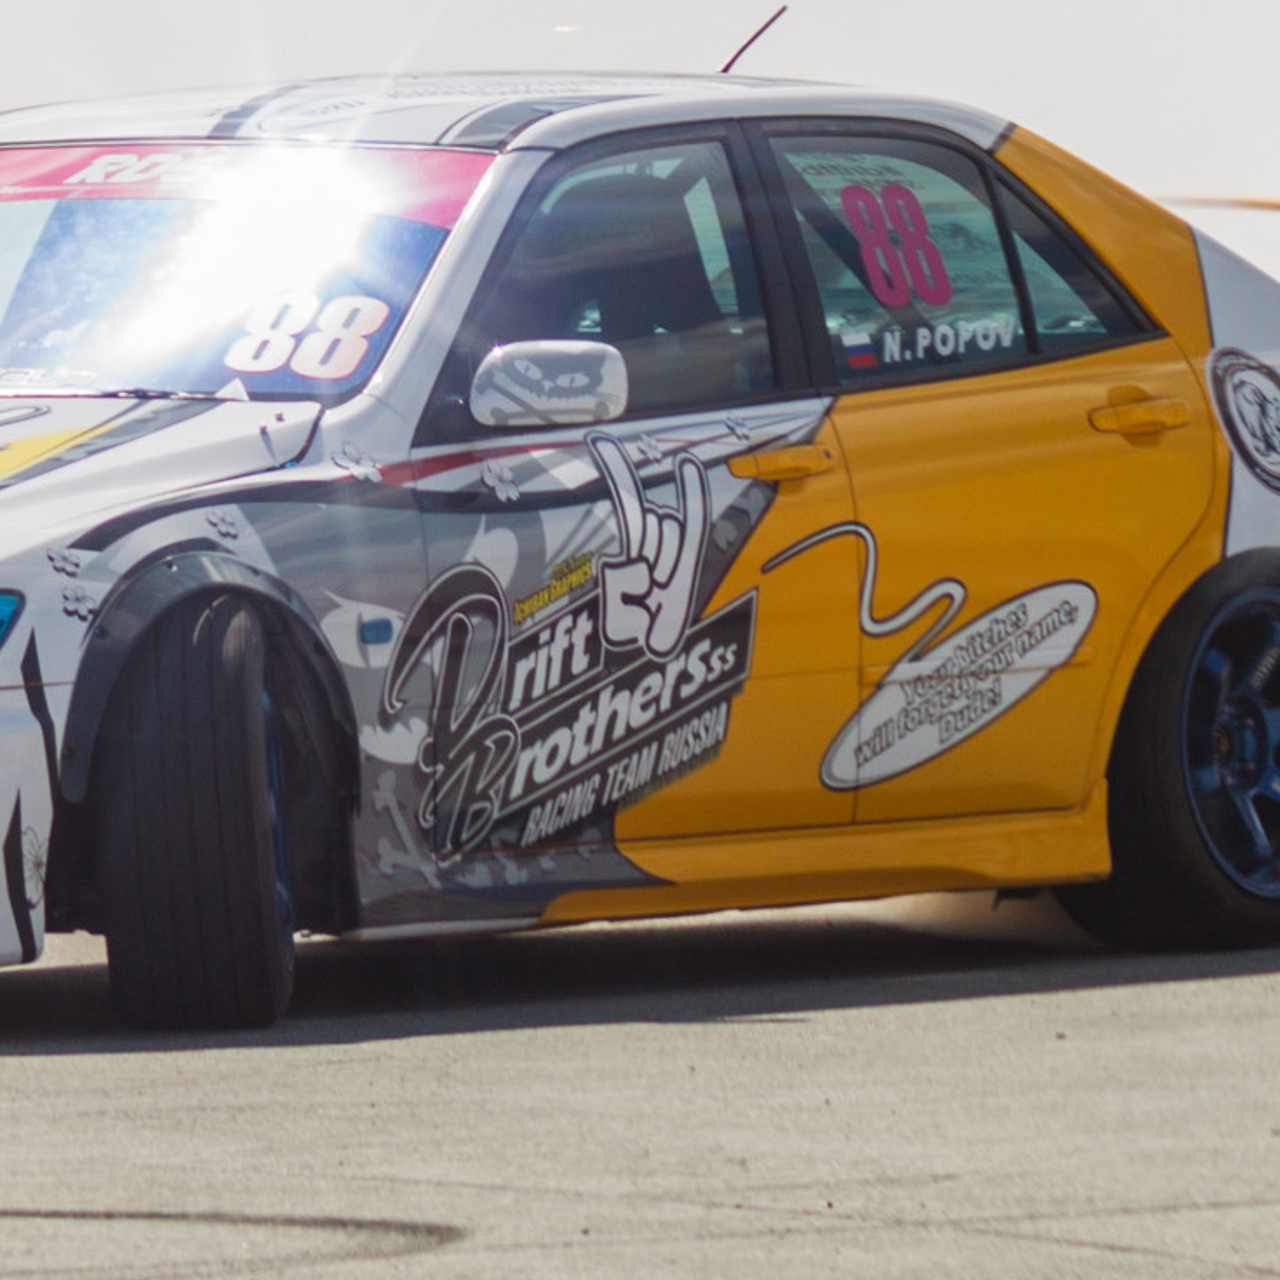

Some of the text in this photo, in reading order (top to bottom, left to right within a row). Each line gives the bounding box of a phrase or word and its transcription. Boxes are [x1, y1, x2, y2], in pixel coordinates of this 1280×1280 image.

[839, 184, 953, 307] 88
[223, 290, 390, 380] 88
[520, 701, 729, 848] RACING TEAM RUSSIA
